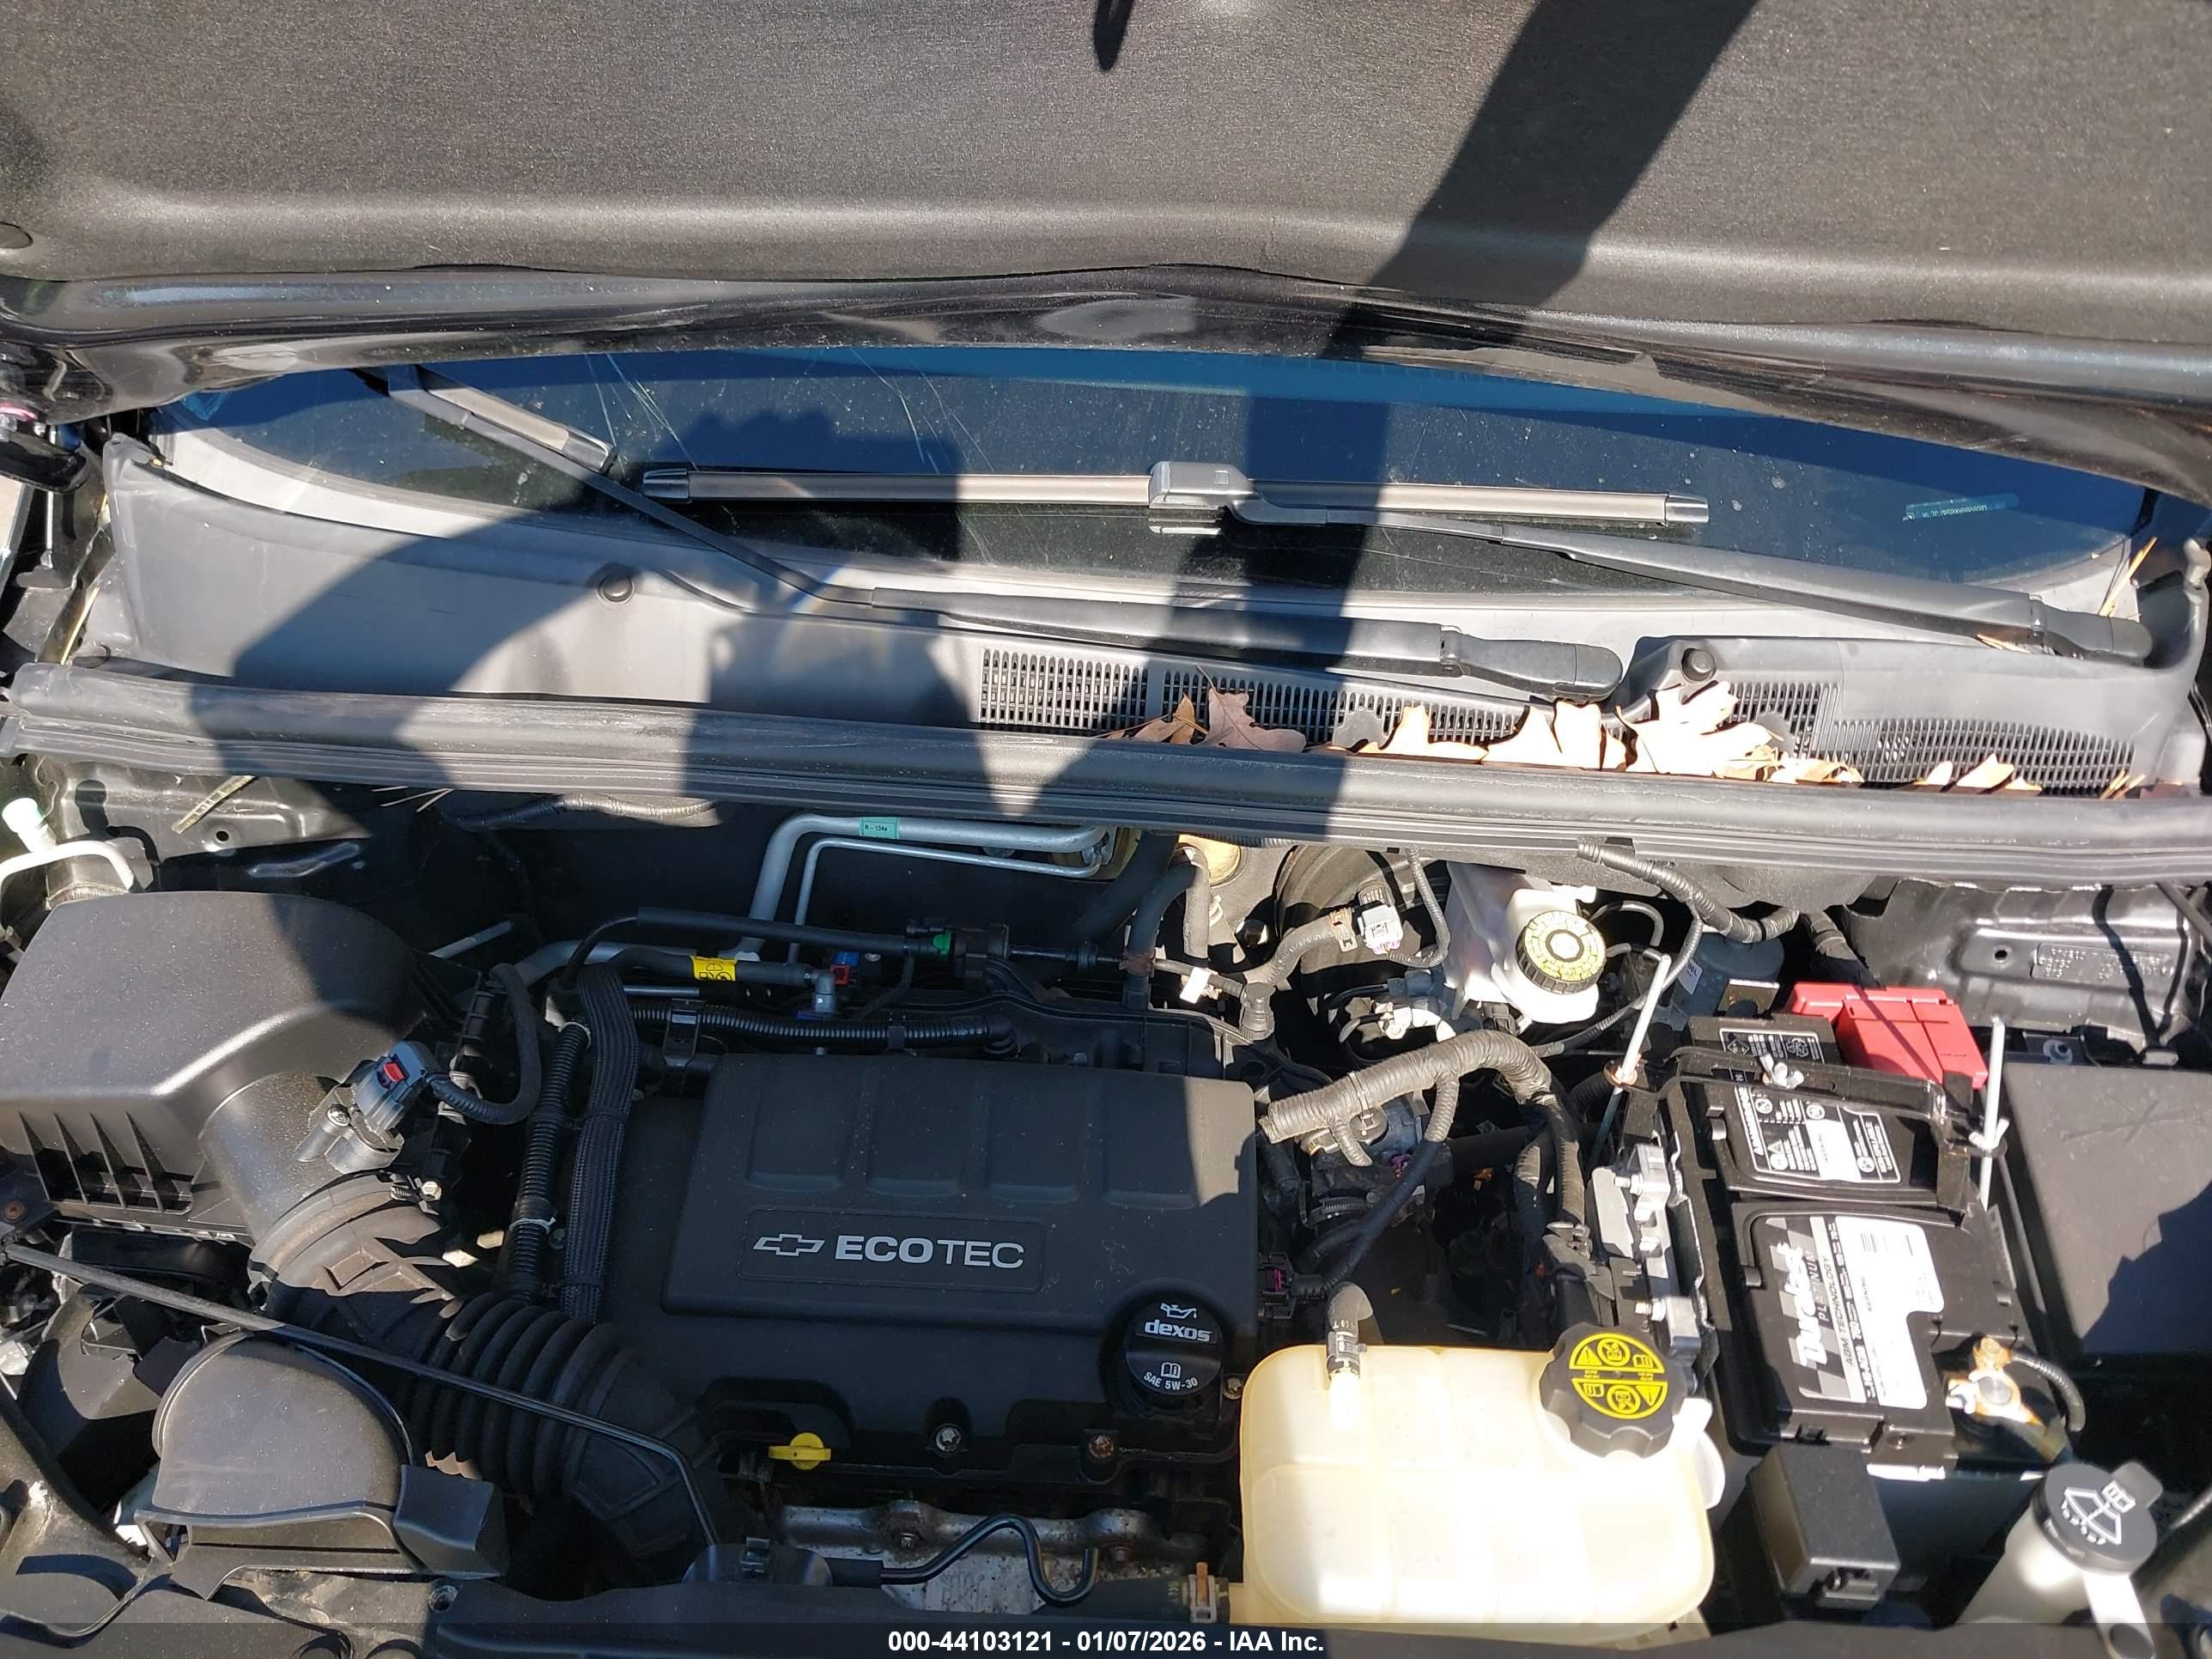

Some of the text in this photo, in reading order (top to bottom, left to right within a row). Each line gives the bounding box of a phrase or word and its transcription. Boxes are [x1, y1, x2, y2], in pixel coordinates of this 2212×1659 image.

[835, 1235, 1024, 1269] ECOTEC
[1805, 1250, 1829, 1323] PLATINUM
[1821, 1255, 1848, 1334] TECHNOLOGY
[1145, 1319, 1213, 1342] dexos
[1839, 1337, 1855, 1365] AGM
[1143, 1371, 1198, 1391] SAE 5W-30
